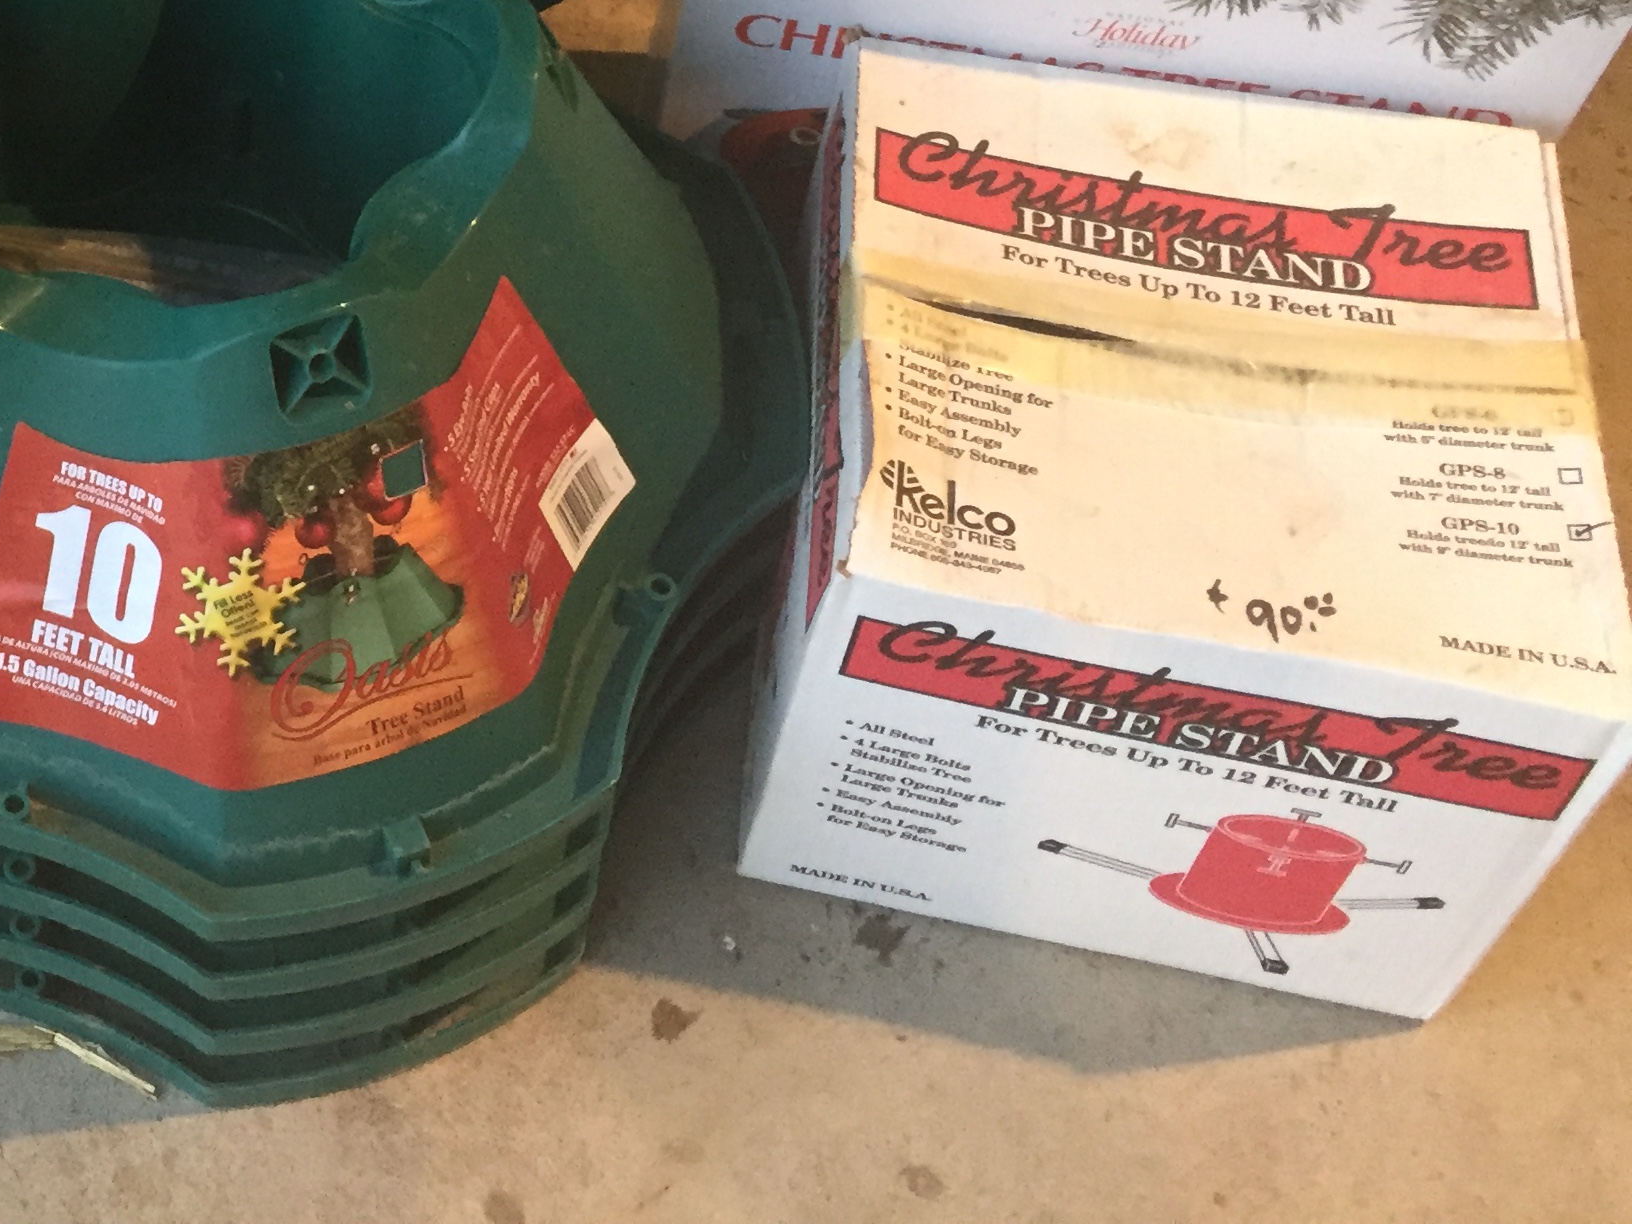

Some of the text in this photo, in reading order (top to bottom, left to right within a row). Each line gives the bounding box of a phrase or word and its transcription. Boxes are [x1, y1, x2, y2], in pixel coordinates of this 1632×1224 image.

[1072, 18, 1200, 49] Holiday
[898, 131, 1513, 272] Christmas Tree
[1019, 206, 1371, 291] PIPE STAND
[1001, 244, 1396, 327] For Trees Up To 12 Feet Tall
[898, 354, 1053, 408] Large Opening for
[898, 372, 1012, 415] Large Trunks
[897, 389, 1021, 438] Easy Assembly
[898, 407, 1003, 450] Bolt-on Legs
[897, 424, 1039, 476] for Easy Storage
[1439, 463, 1506, 479] GPS-8
[52, 475, 166, 525] PARA ARBOLES DE NAVIDAD
[61, 461, 163, 513] FOR TREES UP TO
[75, 490, 144, 524] CON MAXIMO DE
[892, 460, 1016, 537] kelco
[1390, 490, 1426, 501] with
[1446, 494, 1515, 508] diameter
[1519, 499, 1564, 512] trunk
[1399, 476, 1443, 489] Holds
[1446, 479, 1478, 492] tree
[1481, 484, 1497, 494] to
[1525, 485, 1552, 497] tall
[893, 507, 1017, 551] INDUSTRIES
[1441, 516, 1520, 535] GPS-10
[35, 505, 163, 644] 10
[1, 636, 16, 647] DE
[15, 640, 49, 657] ALTURA
[31, 618, 136, 679] FEET TALL
[1438, 635, 1618, 674] MADE IN U.S.A.
[11, 676, 32, 688] UNA
[32, 679, 81, 704] CAPACIDAD
[82, 695, 95, 707] DE
[108, 707, 138, 726] LITROS
[23, 658, 81, 690] Gallon
[82, 679, 159, 726] Capacity
[270, 626, 455, 734] Oasis
[365, 685, 465, 736] Tree Stand
[878, 621, 1561, 790] Christmas Tree
[854, 738, 971, 772] 4 Large Bolts
[859, 722, 934, 747] All Steel
[1004, 686, 1398, 785] PIPE STAND
[845, 763, 1006, 808] Large Opening for
[850, 748, 972, 784] Stabilize Tree
[976, 715, 1398, 813] For Trees Up To 12 Feet Tall
[836, 789, 963, 826] Easy Assembly
[841, 774, 959, 809] Large Trunks
[827, 814, 967, 853] for Easy Storage
[831, 803, 937, 836] Bolt-on Legs
[790, 864, 849, 883] MADE
[853, 877, 875, 890] IN
